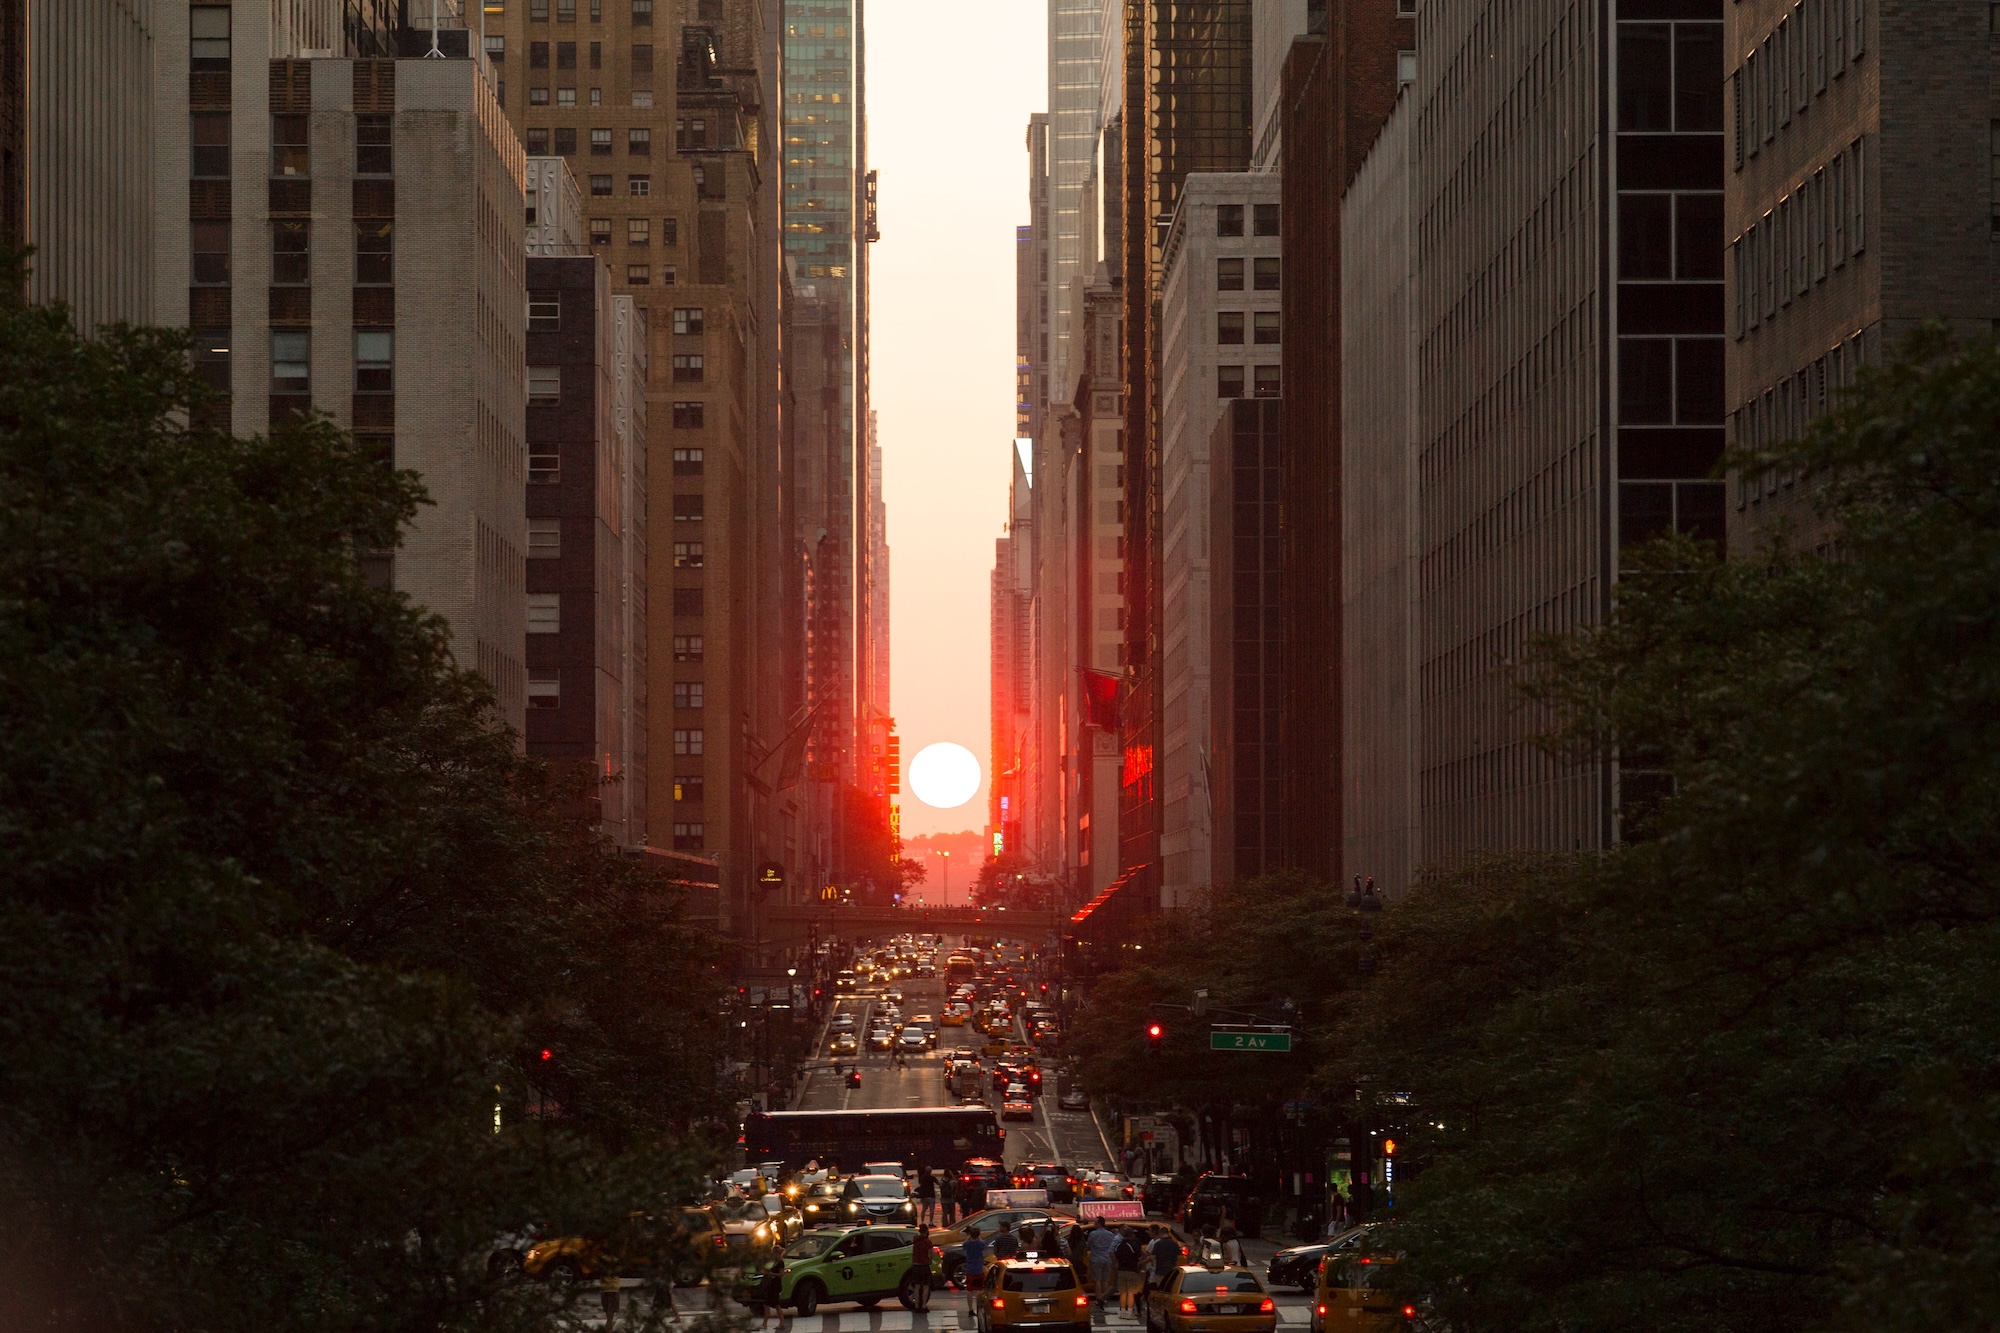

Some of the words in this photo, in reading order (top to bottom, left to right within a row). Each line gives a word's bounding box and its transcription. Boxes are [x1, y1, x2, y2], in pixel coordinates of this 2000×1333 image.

[1235, 1036, 1244, 1047] 2
[1248, 1037, 1266, 1047] Av
[1083, 1203, 1115, 1212] HELLO
